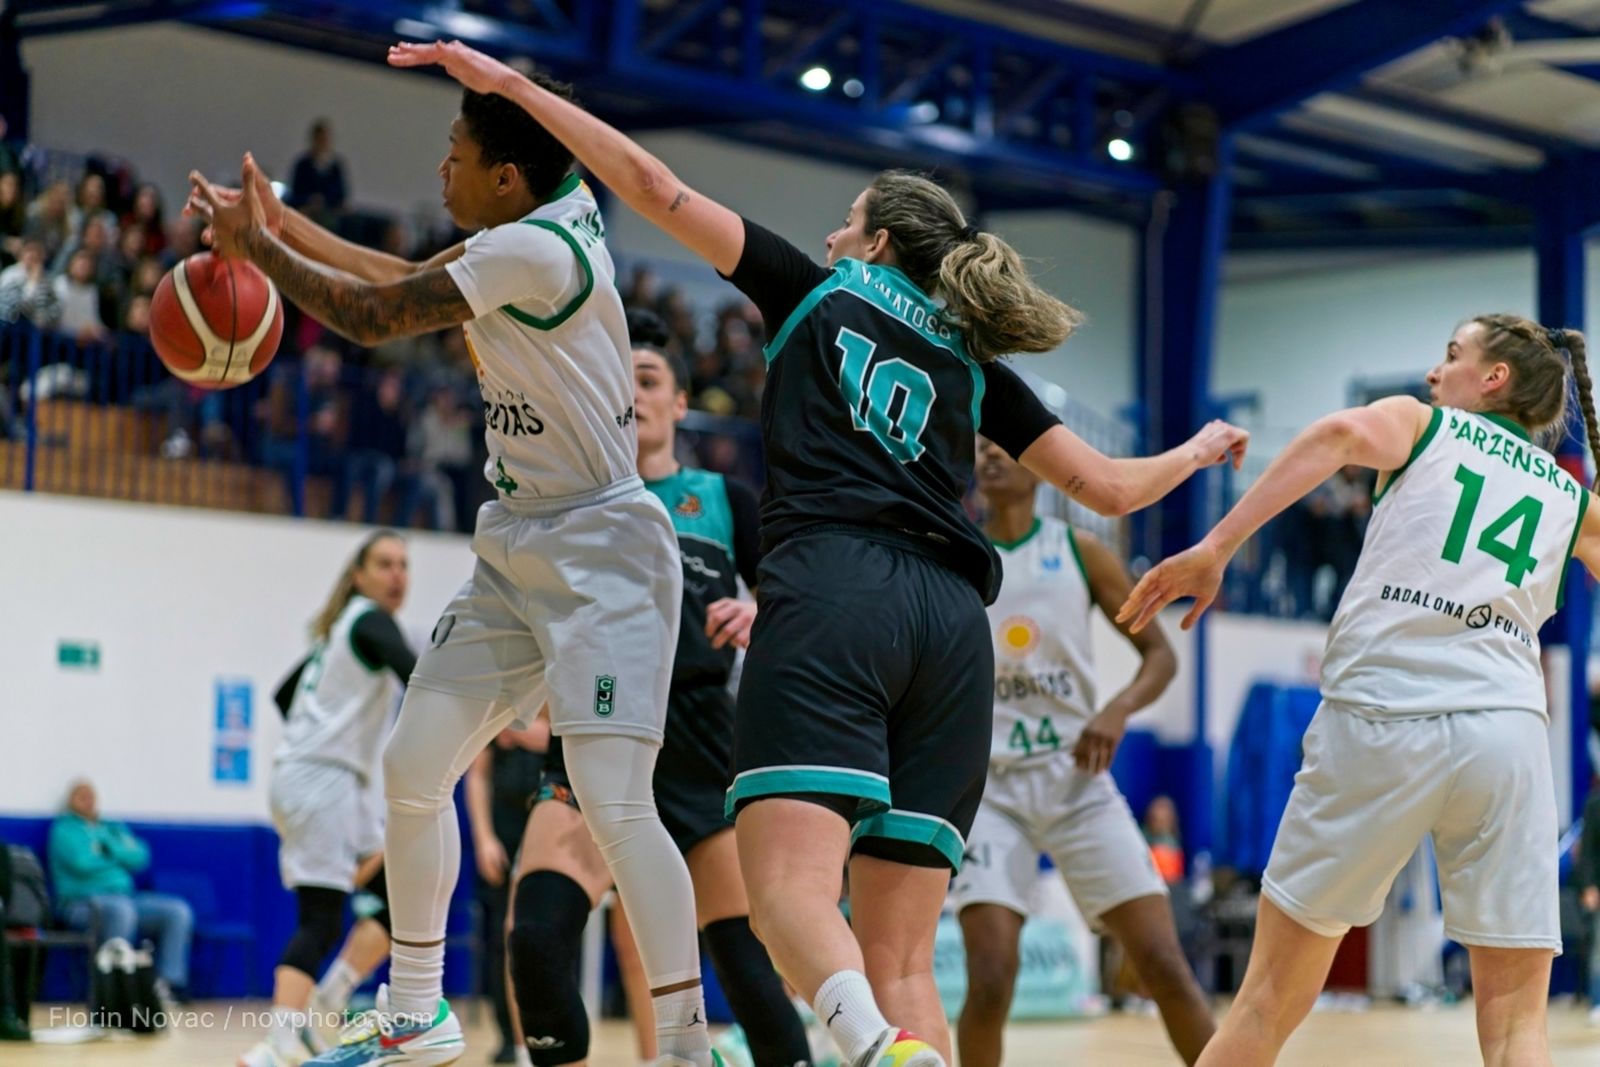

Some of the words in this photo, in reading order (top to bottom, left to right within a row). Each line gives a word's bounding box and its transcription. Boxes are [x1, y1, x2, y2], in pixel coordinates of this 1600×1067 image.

[834, 325, 938, 465] 10
[1440, 462, 1544, 589] 14
[1380, 585, 1465, 621] BADALONA
[598, 679, 613, 713] CJB
[1008, 715, 1061, 756] 44
